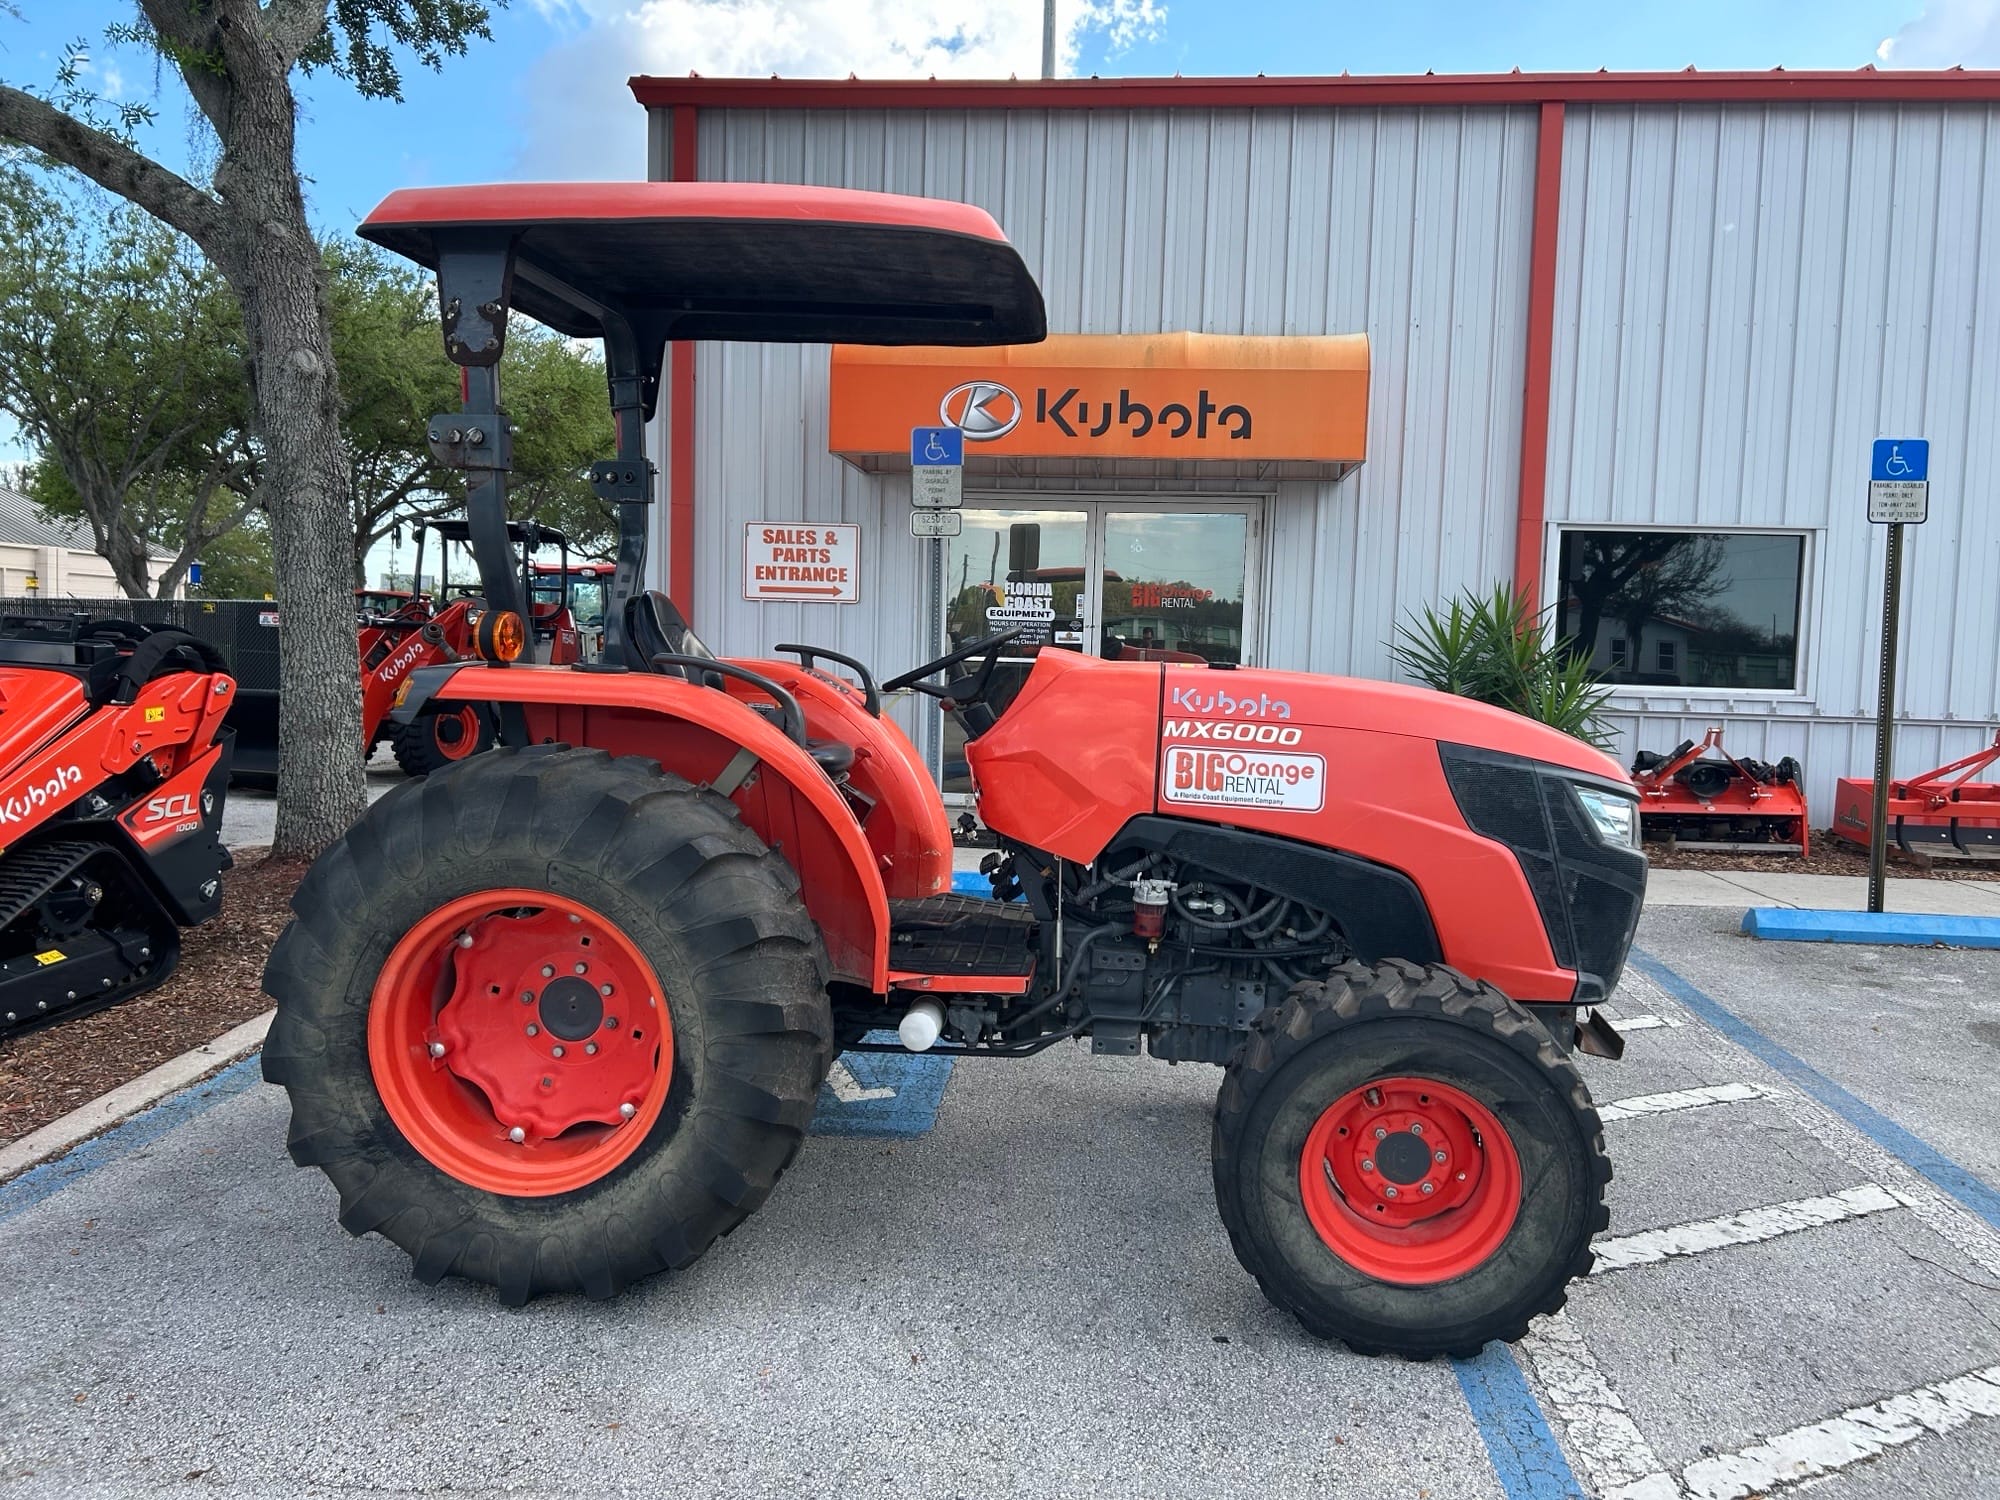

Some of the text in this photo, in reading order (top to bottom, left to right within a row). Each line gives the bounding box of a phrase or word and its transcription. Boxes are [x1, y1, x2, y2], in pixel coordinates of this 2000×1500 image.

[1036, 388, 1252, 440] Kubota
[763, 529, 838, 546] SALES &
[772, 547, 831, 564] PARTS
[755, 565, 848, 583] ENTRANCE
[1005, 582, 1052, 596] FLORIDA
[1160, 584, 1213, 602] Orange
[1005, 597, 1053, 609] COAST
[1161, 597, 1196, 608] RENTAL
[990, 610, 1052, 618] EQUIPMENT
[379, 642, 425, 683] Kubota
[1172, 687, 1291, 719] Kubota
[1163, 720, 1303, 746] MX6000
[1175, 751, 1315, 792] BIG Orange
[1225, 775, 1285, 796] RENTAL
[0, 765, 83, 825] Kubota
[1180, 792, 1201, 800] Florida
[1202, 793, 1220, 801] Coast
[1221, 794, 1254, 804] Equipment
[1255, 796, 1284, 806] Company
[144, 793, 198, 822] SCL
[175, 821, 198, 833] 1000
